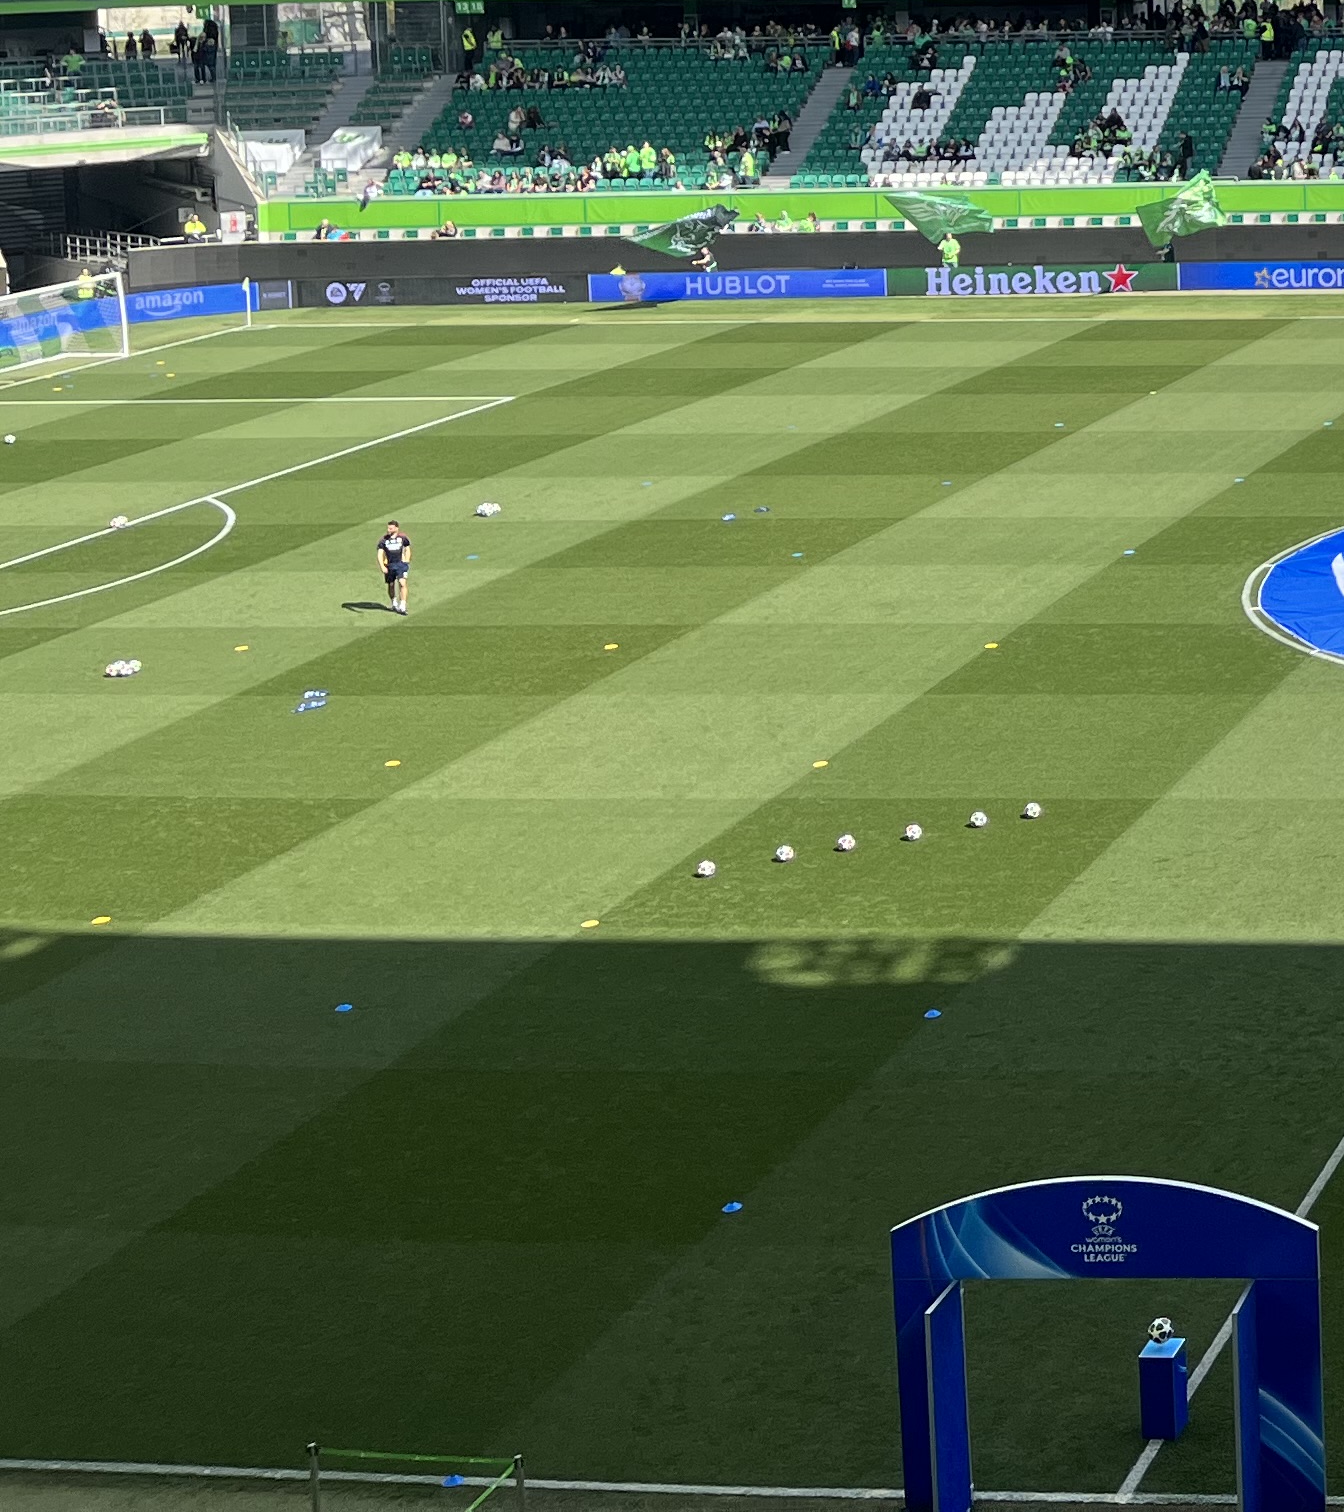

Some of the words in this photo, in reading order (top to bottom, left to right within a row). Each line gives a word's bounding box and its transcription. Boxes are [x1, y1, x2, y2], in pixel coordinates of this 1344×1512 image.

[471, 278, 520, 287] OFFICIAL
[685, 274, 790, 295] HUBLOT
[925, 265, 1101, 296] Heineken
[135, 288, 205, 311] amazon
[1070, 1244, 1138, 1253] CHAMPIONS
[1084, 1253, 1125, 1262] LEAGUE
